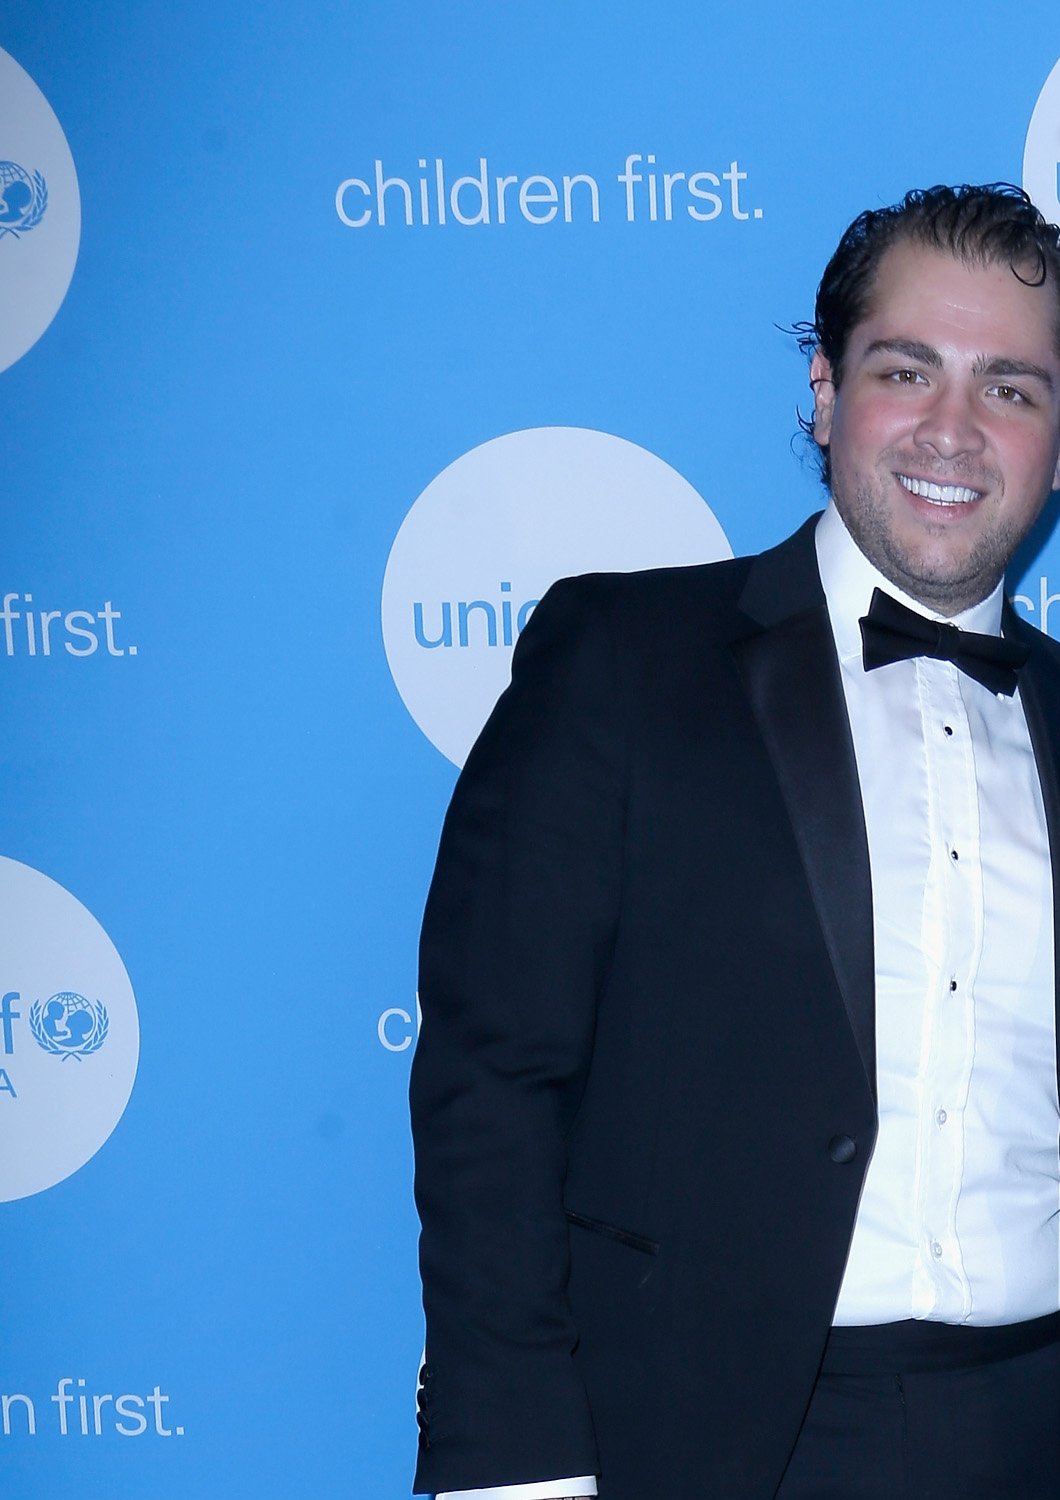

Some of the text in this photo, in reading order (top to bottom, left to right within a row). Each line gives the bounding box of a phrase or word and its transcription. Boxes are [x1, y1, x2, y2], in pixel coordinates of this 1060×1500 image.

[336, 154, 764, 227] children first.
[0, 593, 137, 656] first.
[51, 1378, 184, 1436] first.
